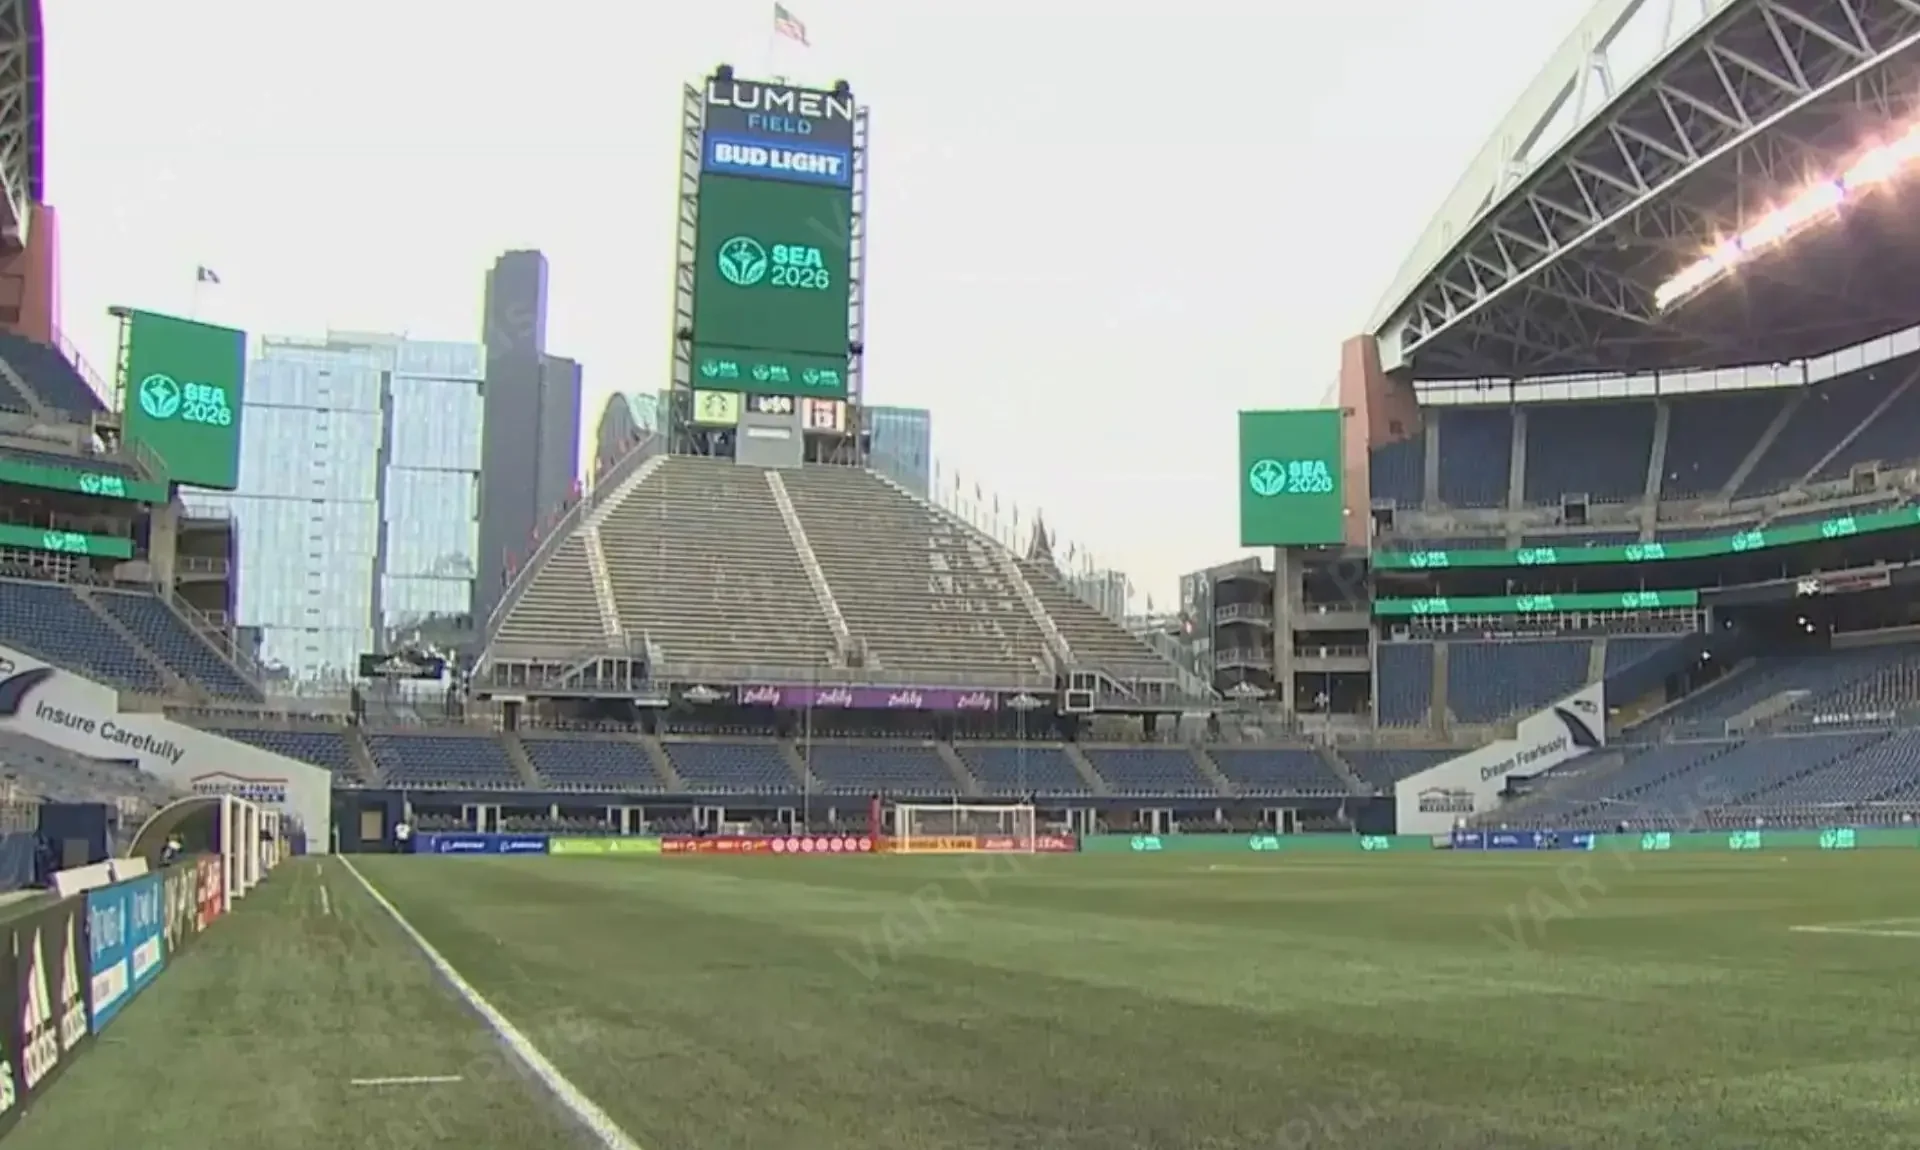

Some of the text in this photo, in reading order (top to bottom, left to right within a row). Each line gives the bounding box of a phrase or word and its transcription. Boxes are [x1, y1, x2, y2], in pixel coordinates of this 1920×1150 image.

[708, 80, 852, 121] LUMEN
[748, 112, 812, 135] FIELD
[714, 143, 841, 175] BUD LIGHT
[772, 243, 822, 268] SEA
[771, 265, 829, 289] 2026
[182, 382, 225, 406] SEA
[181, 402, 232, 426] 2026
[1288, 460, 1328, 479] SEA
[1288, 476, 1333, 493] 2026
[35, 700, 186, 765] Insure Carefully
[1480, 735, 1567, 783] Dream Fearlessly
